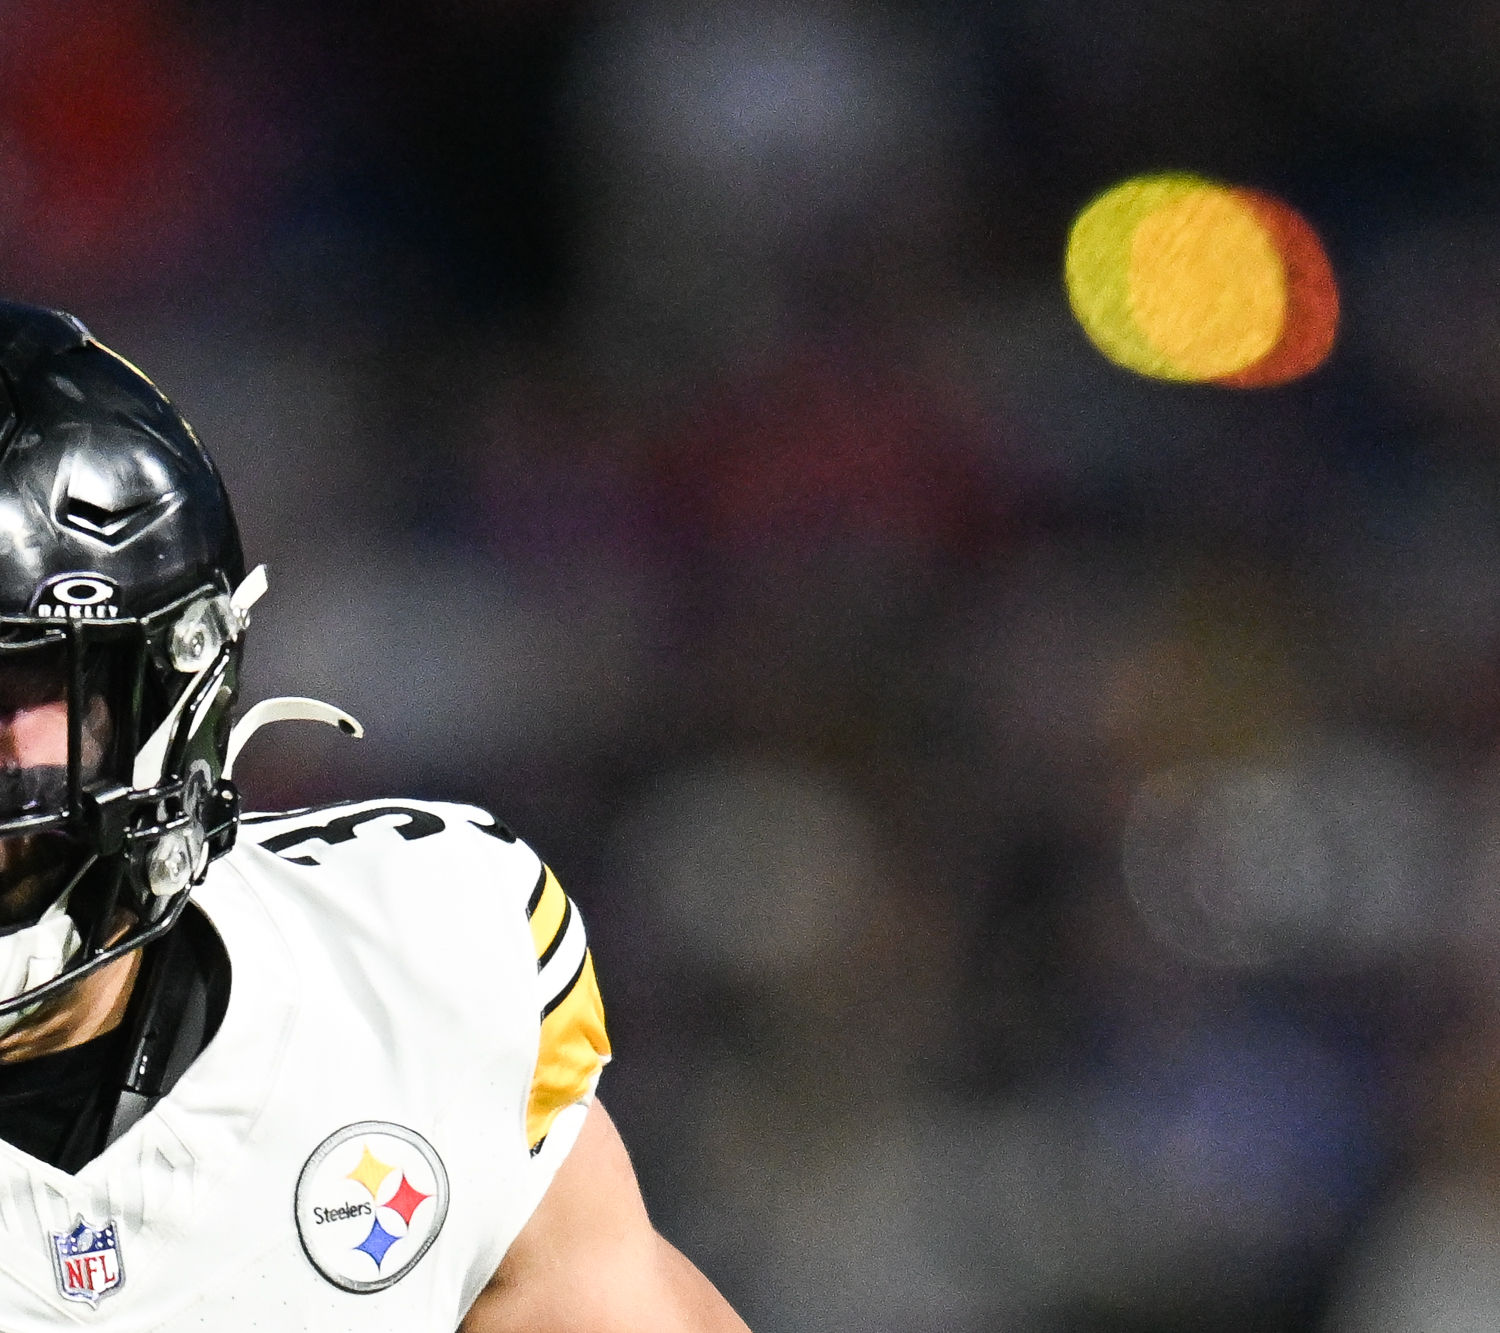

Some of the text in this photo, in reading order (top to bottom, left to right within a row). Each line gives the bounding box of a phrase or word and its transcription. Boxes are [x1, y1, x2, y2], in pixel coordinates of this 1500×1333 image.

[37, 604, 119, 619] OAKLEY
[313, 1201, 372, 1225] Steelers
[65, 1254, 116, 1291] NFL
